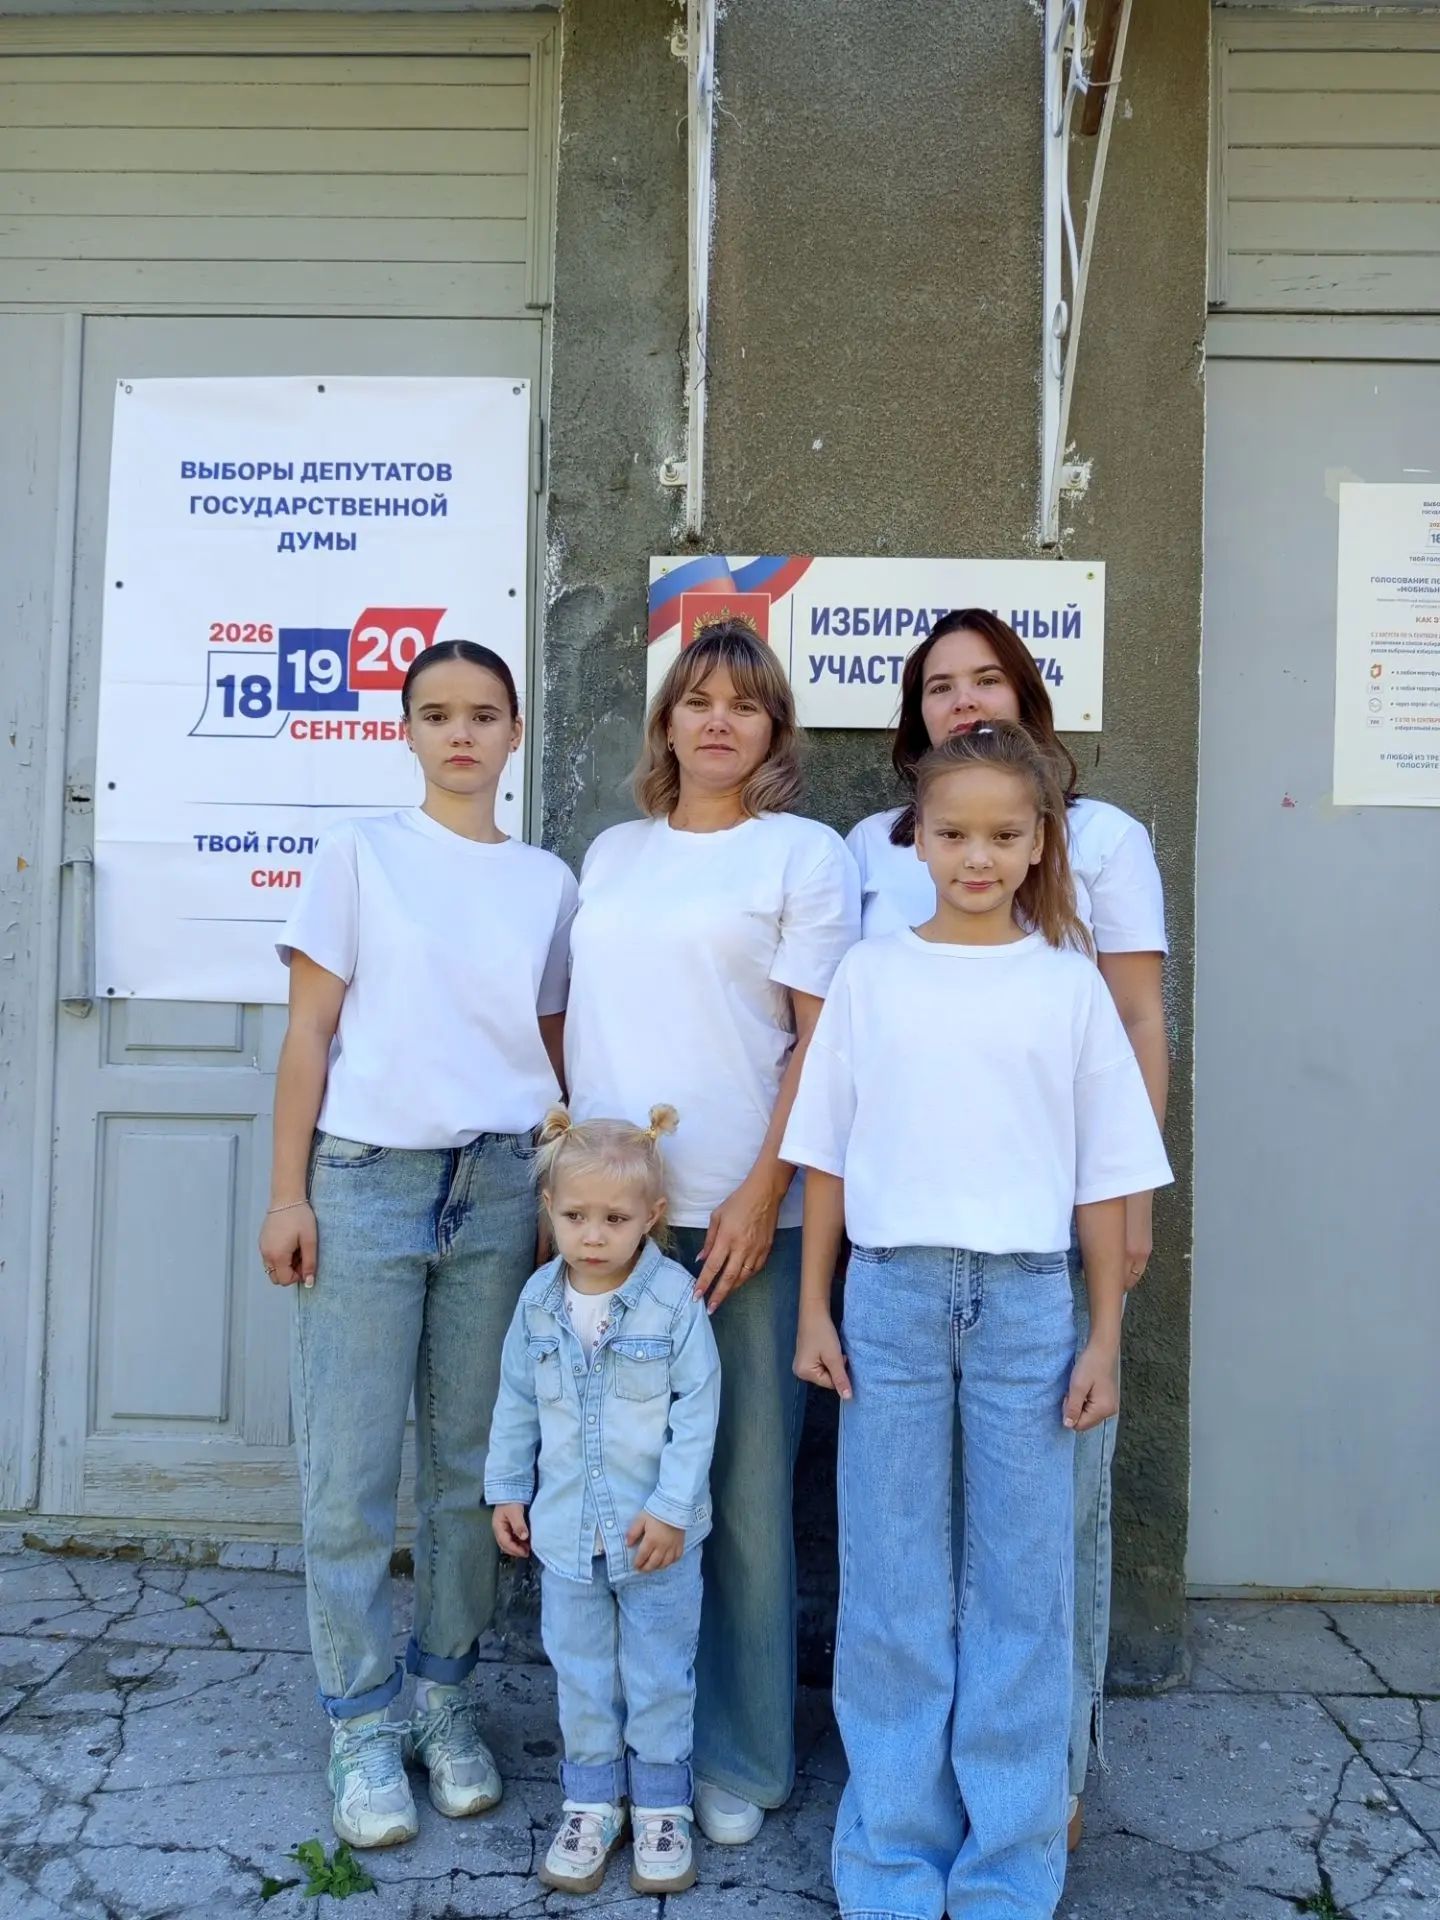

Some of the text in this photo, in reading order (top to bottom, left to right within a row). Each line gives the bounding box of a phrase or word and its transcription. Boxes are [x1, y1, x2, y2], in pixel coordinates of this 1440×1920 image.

[180, 460, 453, 484] ВЫБОРЫ ДЕПУТАТОВ
[190, 491, 448, 519] ГОСУДАРСТВЕННОЙ
[277, 531, 357, 553] ДУМЫ
[1370, 576, 1430, 585] ГОЛОСОВАНИЕ
[208, 622, 274, 644] 2026
[811, 603, 1081, 639] ИЗБИРАНЫЙ
[216, 626, 426, 719] 18 19 20
[809, 654, 904, 686] УЧАСТ
[289, 718, 405, 742] СЕНТЯБ
[1386, 753, 1414, 761] ЛЮБОЙ
[193, 830, 320, 855] ТВОЙ ГОЛ
[250, 869, 302, 889] СИЛ
